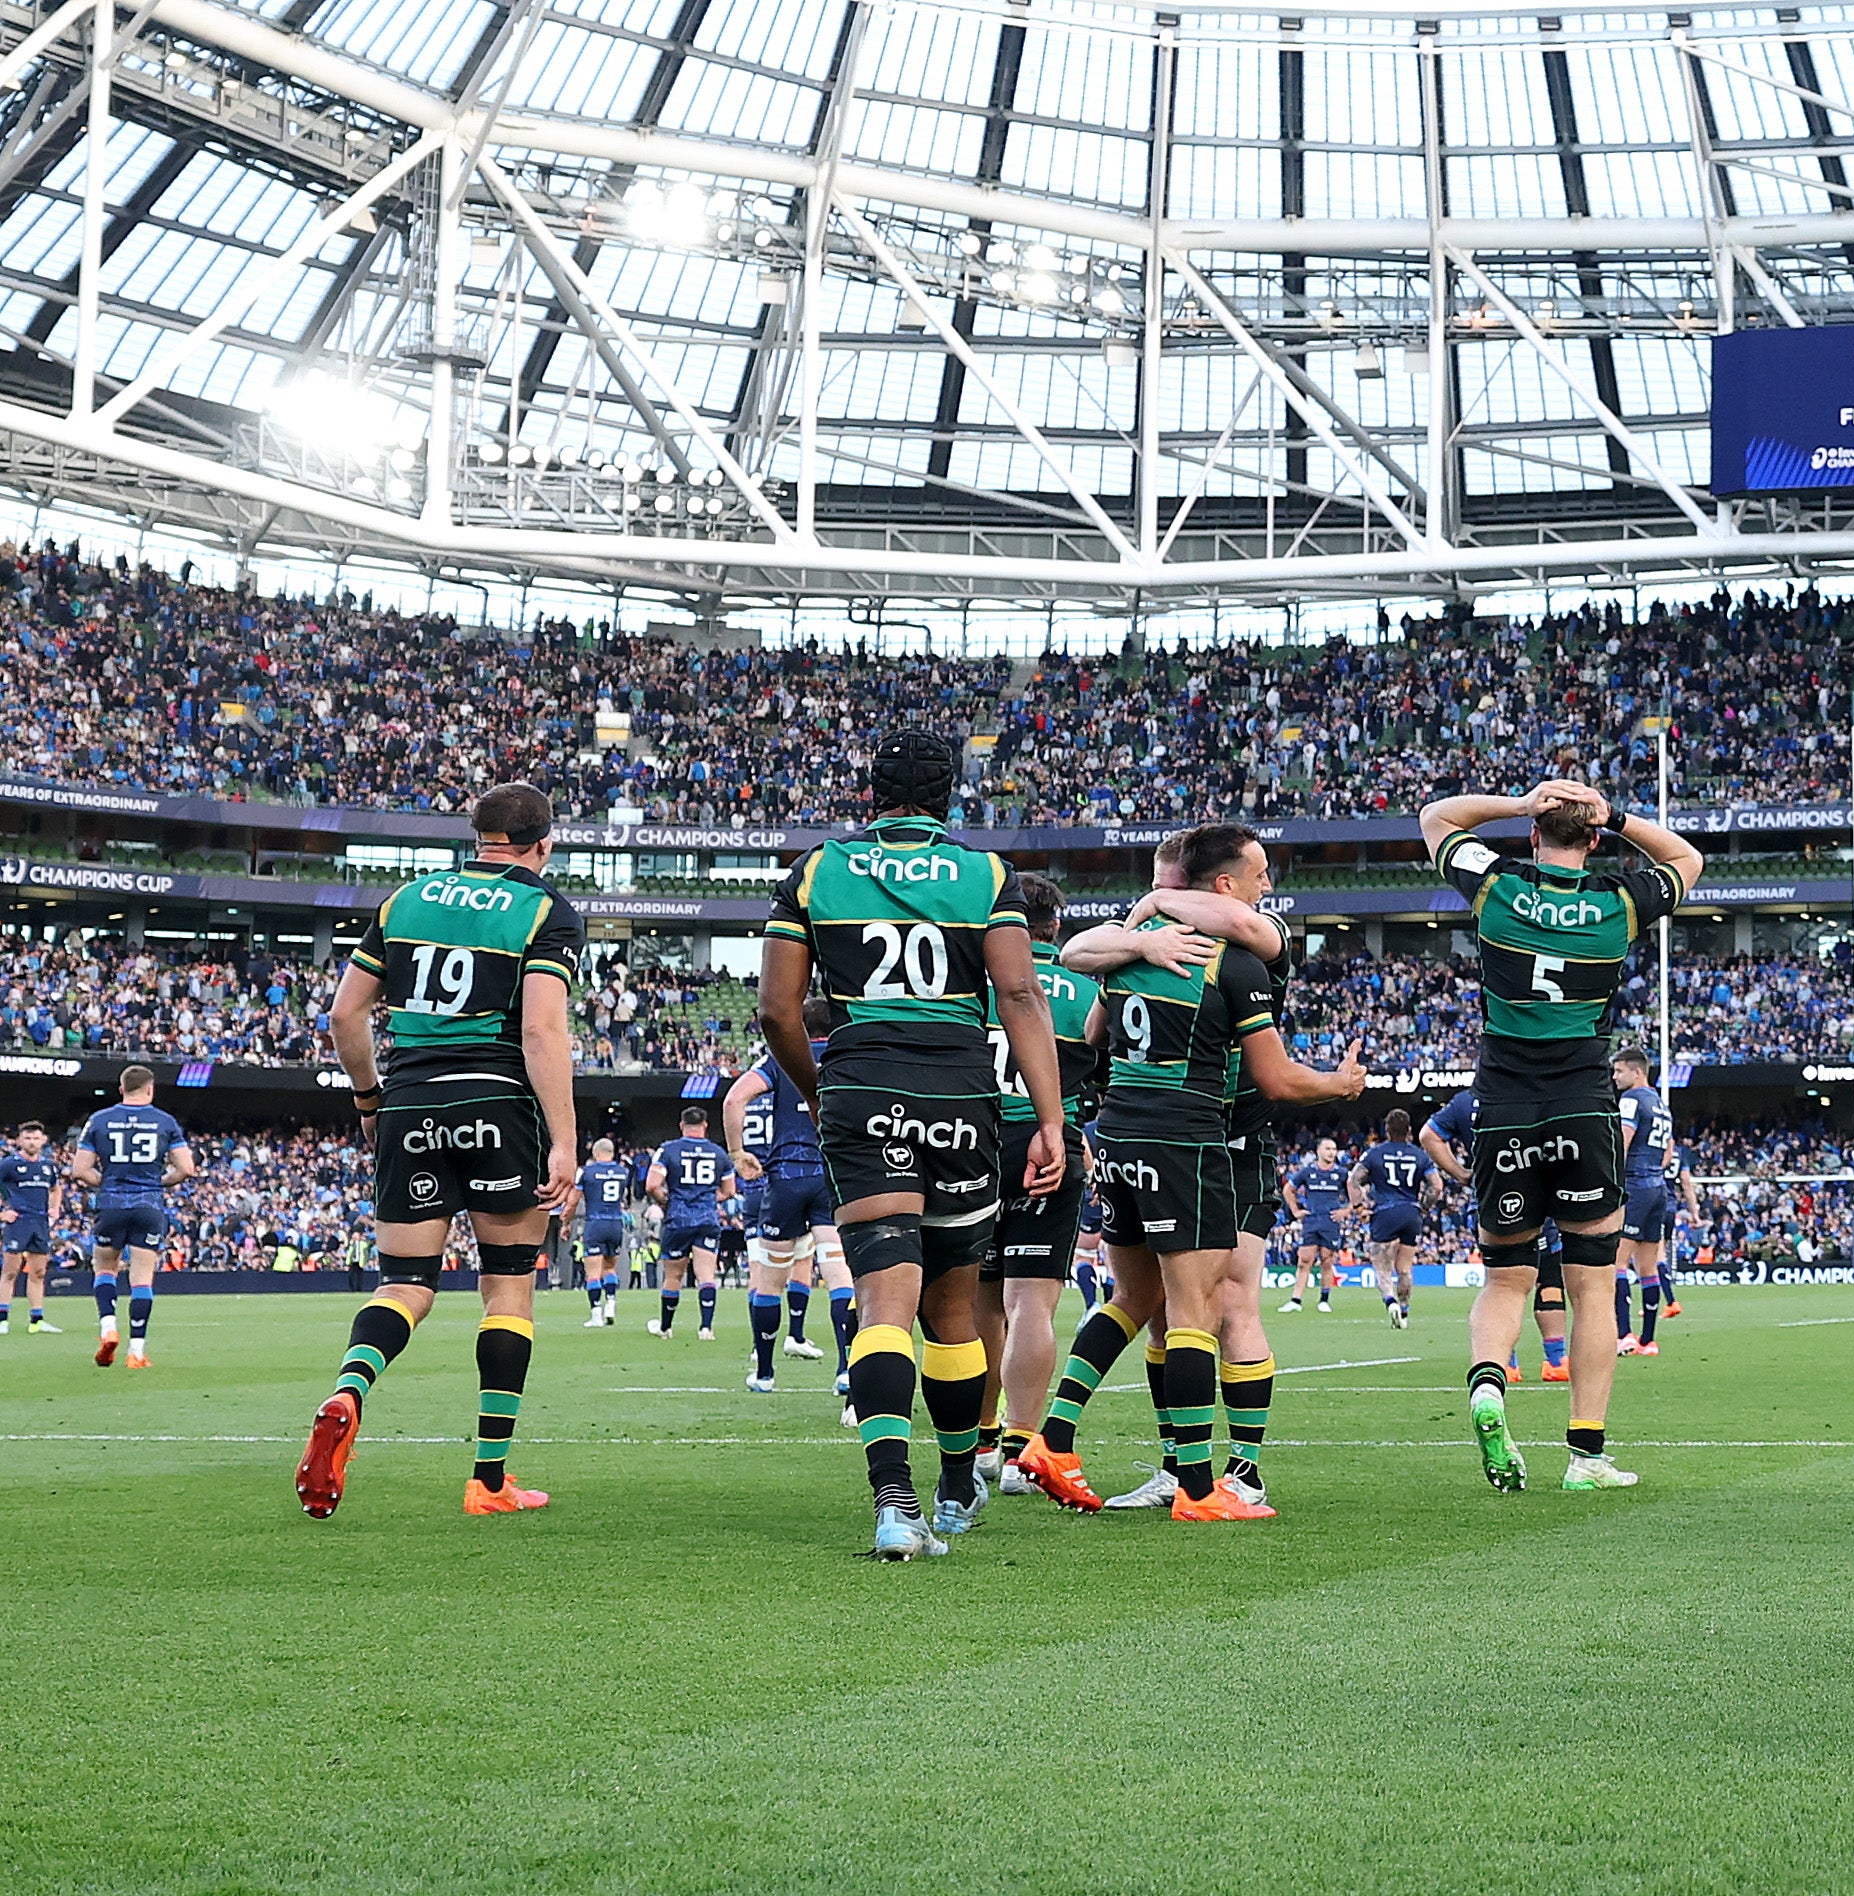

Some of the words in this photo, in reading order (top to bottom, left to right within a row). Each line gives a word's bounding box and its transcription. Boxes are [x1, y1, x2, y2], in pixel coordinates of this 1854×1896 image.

[0, 784, 34, 800] YEARS
[35, 789, 51, 801] OF
[53, 791, 159, 813] EXTRAORDINARY
[1737, 810, 1843, 829] CHAMPIONS
[551, 827, 595, 844] stec
[635, 828, 744, 847] CHAMPIONS
[748, 830, 787, 848] CUP
[1121, 831, 1160, 843] YEARS
[848, 847, 959, 882] cinch
[29, 865, 134, 891] CHAMPIONS
[136, 875, 173, 893] CUP
[420, 876, 513, 911] cinch
[1260, 897, 1295, 913] CUP
[1688, 887, 1796, 902] EXTRAORDINARY
[590, 901, 703, 915] EXTRAORDINARY
[1056, 903, 1121, 918] vestec
[1512, 891, 1602, 927] cinch
[862, 921, 949, 1000] 20
[406, 945, 474, 1015] 19
[1531, 953, 1565, 1003] 5
[1122, 994, 1151, 1064] 9
[0, 1056, 54, 1075] AMPIONS
[54, 1059, 81, 1077] CUP
[403, 1118, 501, 1154] cinch
[867, 1103, 978, 1150] cinch
[1647, 1116, 1672, 1150] 22
[109, 1132, 158, 1163] 13
[1496, 1135, 1580, 1173] cinch
[680, 1159, 716, 1185] 16
[1093, 1148, 1159, 1192] cinch
[1384, 1162, 1417, 1187] 17
[412, 1179, 434, 1196] TP
[603, 1180, 620, 1202] 9
[1502, 1198, 1521, 1213] TP
[1676, 1269, 1731, 1286] estec
